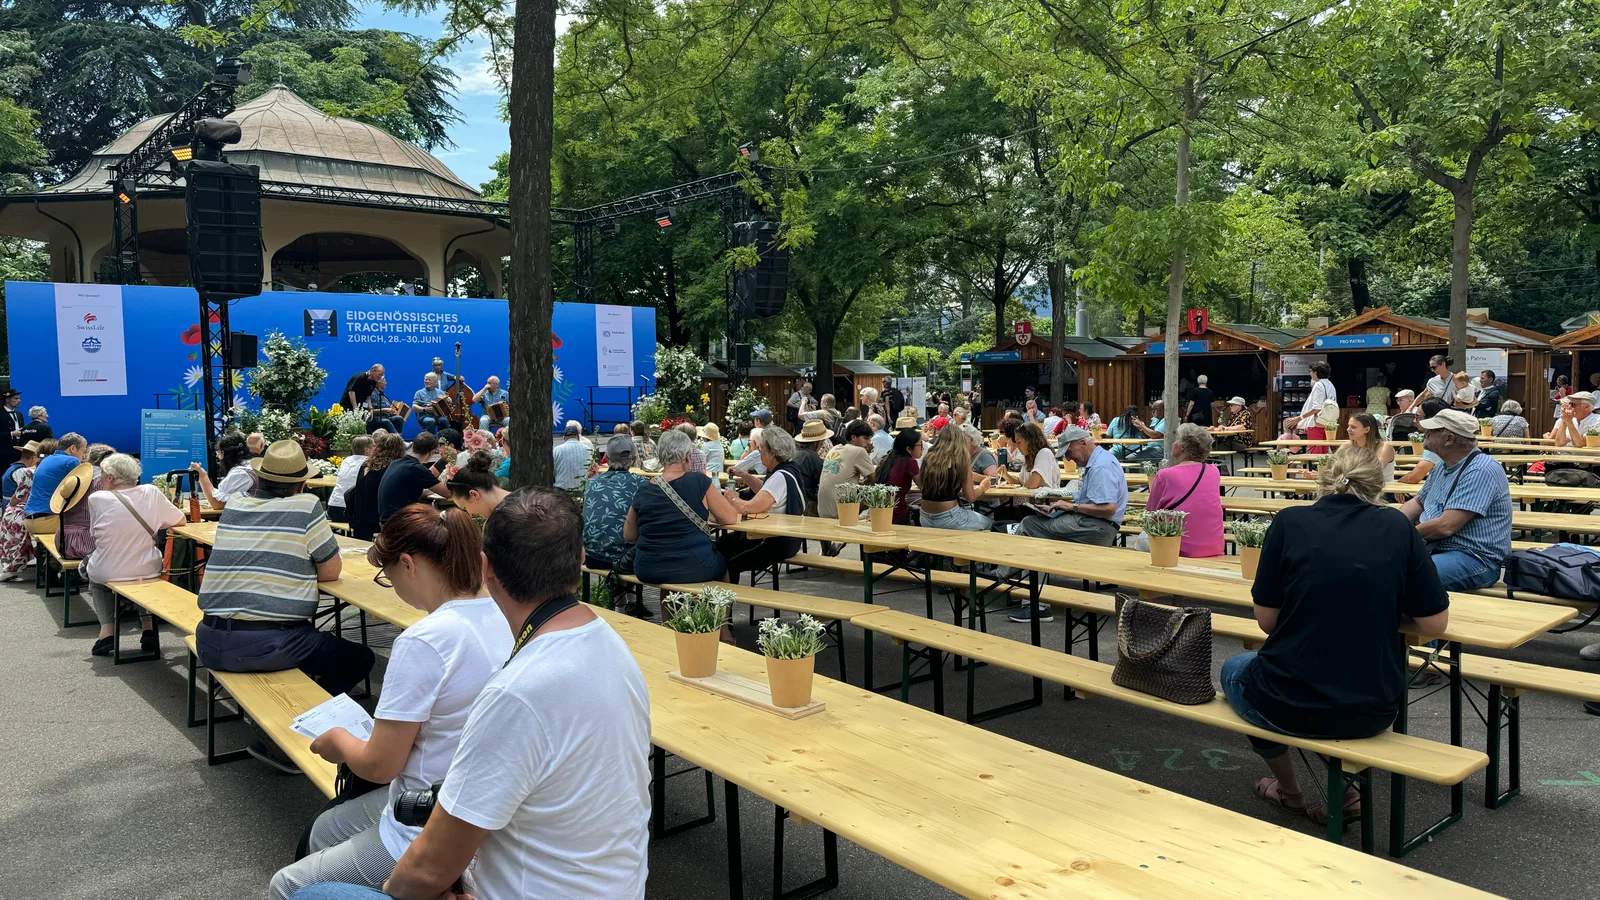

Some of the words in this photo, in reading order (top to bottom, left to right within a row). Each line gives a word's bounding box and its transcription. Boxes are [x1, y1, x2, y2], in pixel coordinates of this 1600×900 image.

[346, 310, 458, 323] EIDGENÖSSISCHES
[346, 322, 440, 334] TRACHTENFEST
[443, 324, 471, 334] 2024
[348, 334, 387, 344] ZÜRICH,
